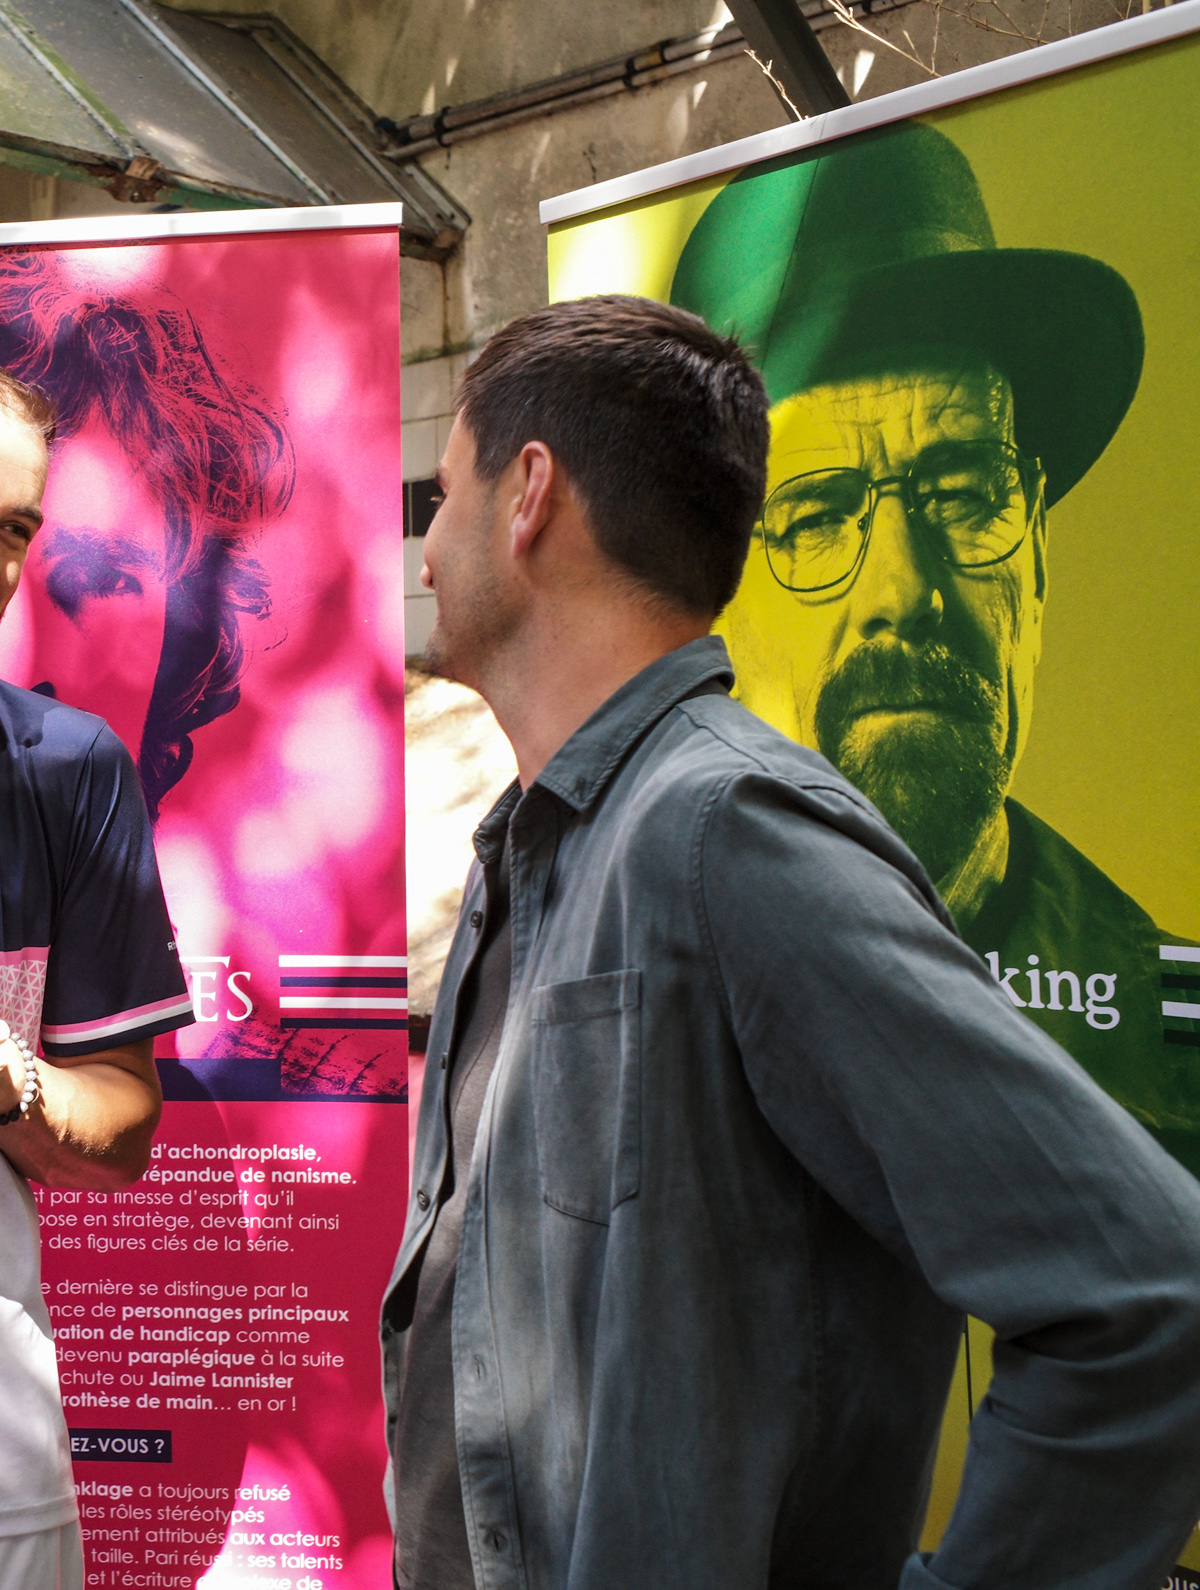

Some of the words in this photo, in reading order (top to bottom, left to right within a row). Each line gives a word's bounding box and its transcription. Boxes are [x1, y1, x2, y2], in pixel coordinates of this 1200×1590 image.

[984, 951, 1120, 1030] king
[151, 1144, 322, 1162] d'achondroplasie,
[142, 1166, 235, 1186] répandue
[240, 1168, 266, 1182] de
[271, 1170, 357, 1184] nanisme.
[51, 1192, 82, 1206] par
[87, 1193, 107, 1204] sa
[114, 1193, 173, 1205] finesse
[179, 1189, 249, 1208] d'esprit
[255, 1191, 294, 1208] qu'il
[83, 1214, 108, 1226] en
[112, 1211, 194, 1231] stratège,
[201, 1214, 292, 1229] devenant
[299, 1215, 339, 1230] ainsi
[49, 1235, 81, 1249] des
[87, 1235, 146, 1252] figures
[152, 1235, 188, 1251] clés
[193, 1237, 218, 1251] de
[224, 1236, 241, 1251] la
[247, 1236, 294, 1252] série.
[57, 1279, 133, 1295] dernière
[139, 1283, 158, 1296] se
[164, 1281, 248, 1300] distingue
[254, 1285, 286, 1300] par
[291, 1284, 308, 1298] la
[91, 1302, 116, 1317] de
[122, 1306, 242, 1321] personnages
[248, 1306, 349, 1323] principaux
[110, 1325, 134, 1340] de
[140, 1326, 230, 1345] handicap
[236, 1330, 309, 1344] comme
[55, 1348, 122, 1363] devenu
[128, 1348, 255, 1367] paraplégique
[261, 1350, 274, 1365] à
[279, 1351, 296, 1366] la
[301, 1352, 344, 1367] suite
[60, 1370, 114, 1385] chute
[120, 1373, 143, 1385] ou
[149, 1371, 206, 1386] Jaime
[212, 1373, 293, 1389] Lannister
[62, 1391, 130, 1408] rothèse
[136, 1394, 160, 1408] de
[238, 1398, 261, 1410] en
[267, 1398, 285, 1411] or
[155, 1439, 165, 1454] ?
[139, 1486, 152, 1498] a
[157, 1483, 229, 1501] toujours
[234, 1484, 291, 1502] refusé
[82, 1503, 105, 1519] les
[110, 1504, 152, 1520] rôles
[157, 1505, 265, 1525] stéréotypés
[82, 1528, 140, 1541] ement
[145, 1528, 225, 1544] attribués
[230, 1531, 265, 1546] aux
[270, 1530, 340, 1547] acteurs
[92, 1549, 138, 1565] taille.
[145, 1550, 178, 1565] Pari
[247, 1556, 276, 1568] ses
[281, 1553, 343, 1570] talents
[88, 1571, 107, 1585] et
[111, 1571, 192, 1588] l'écriture
